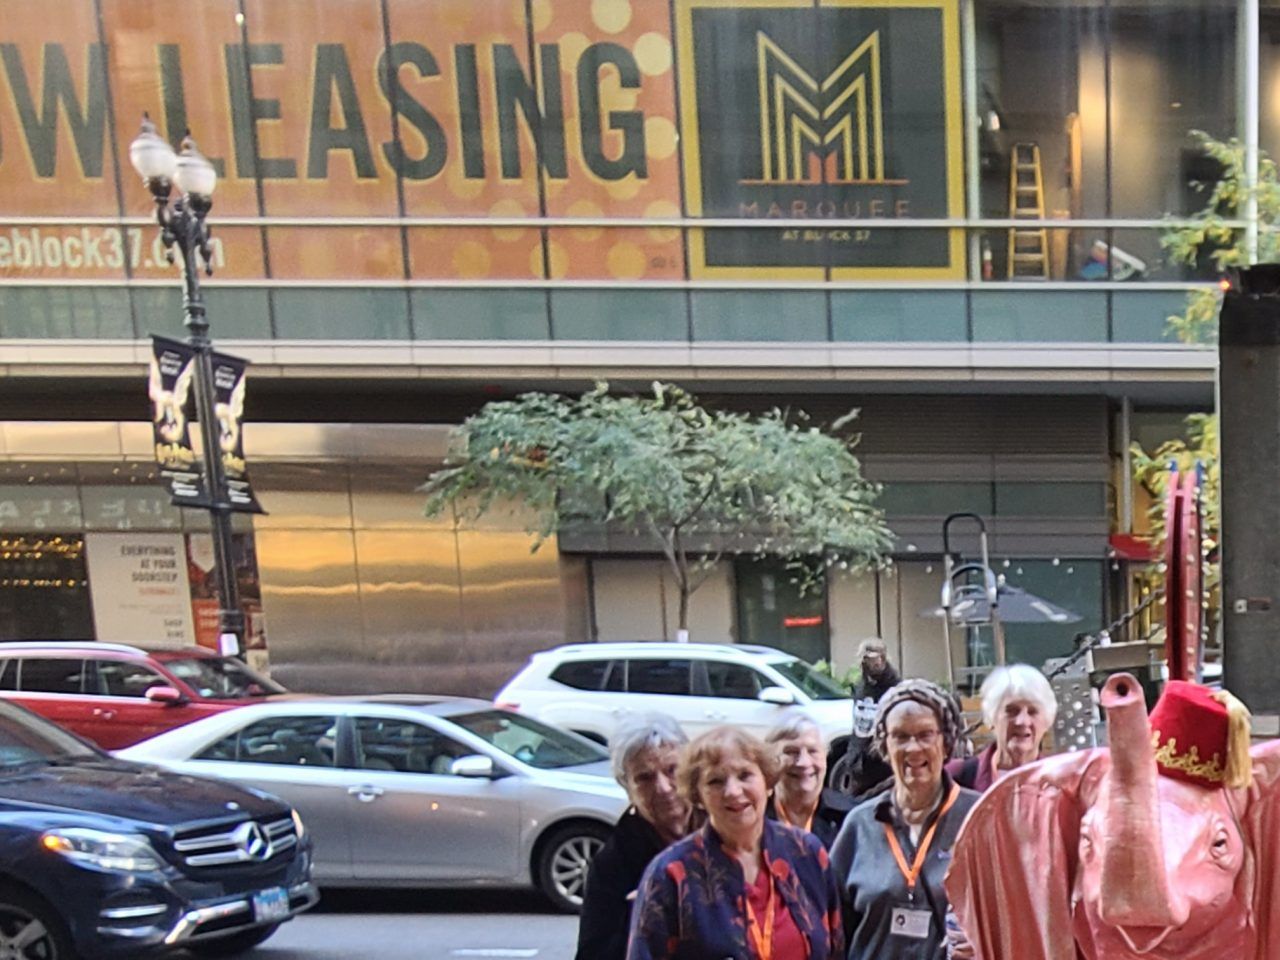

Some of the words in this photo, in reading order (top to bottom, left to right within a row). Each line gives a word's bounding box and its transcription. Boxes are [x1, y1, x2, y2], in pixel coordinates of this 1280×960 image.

[0, 42, 107, 178] W
[157, 42, 649, 181] LEASING
[738, 199, 912, 218] MARQUEE
[803, 229, 852, 241] BLCK
